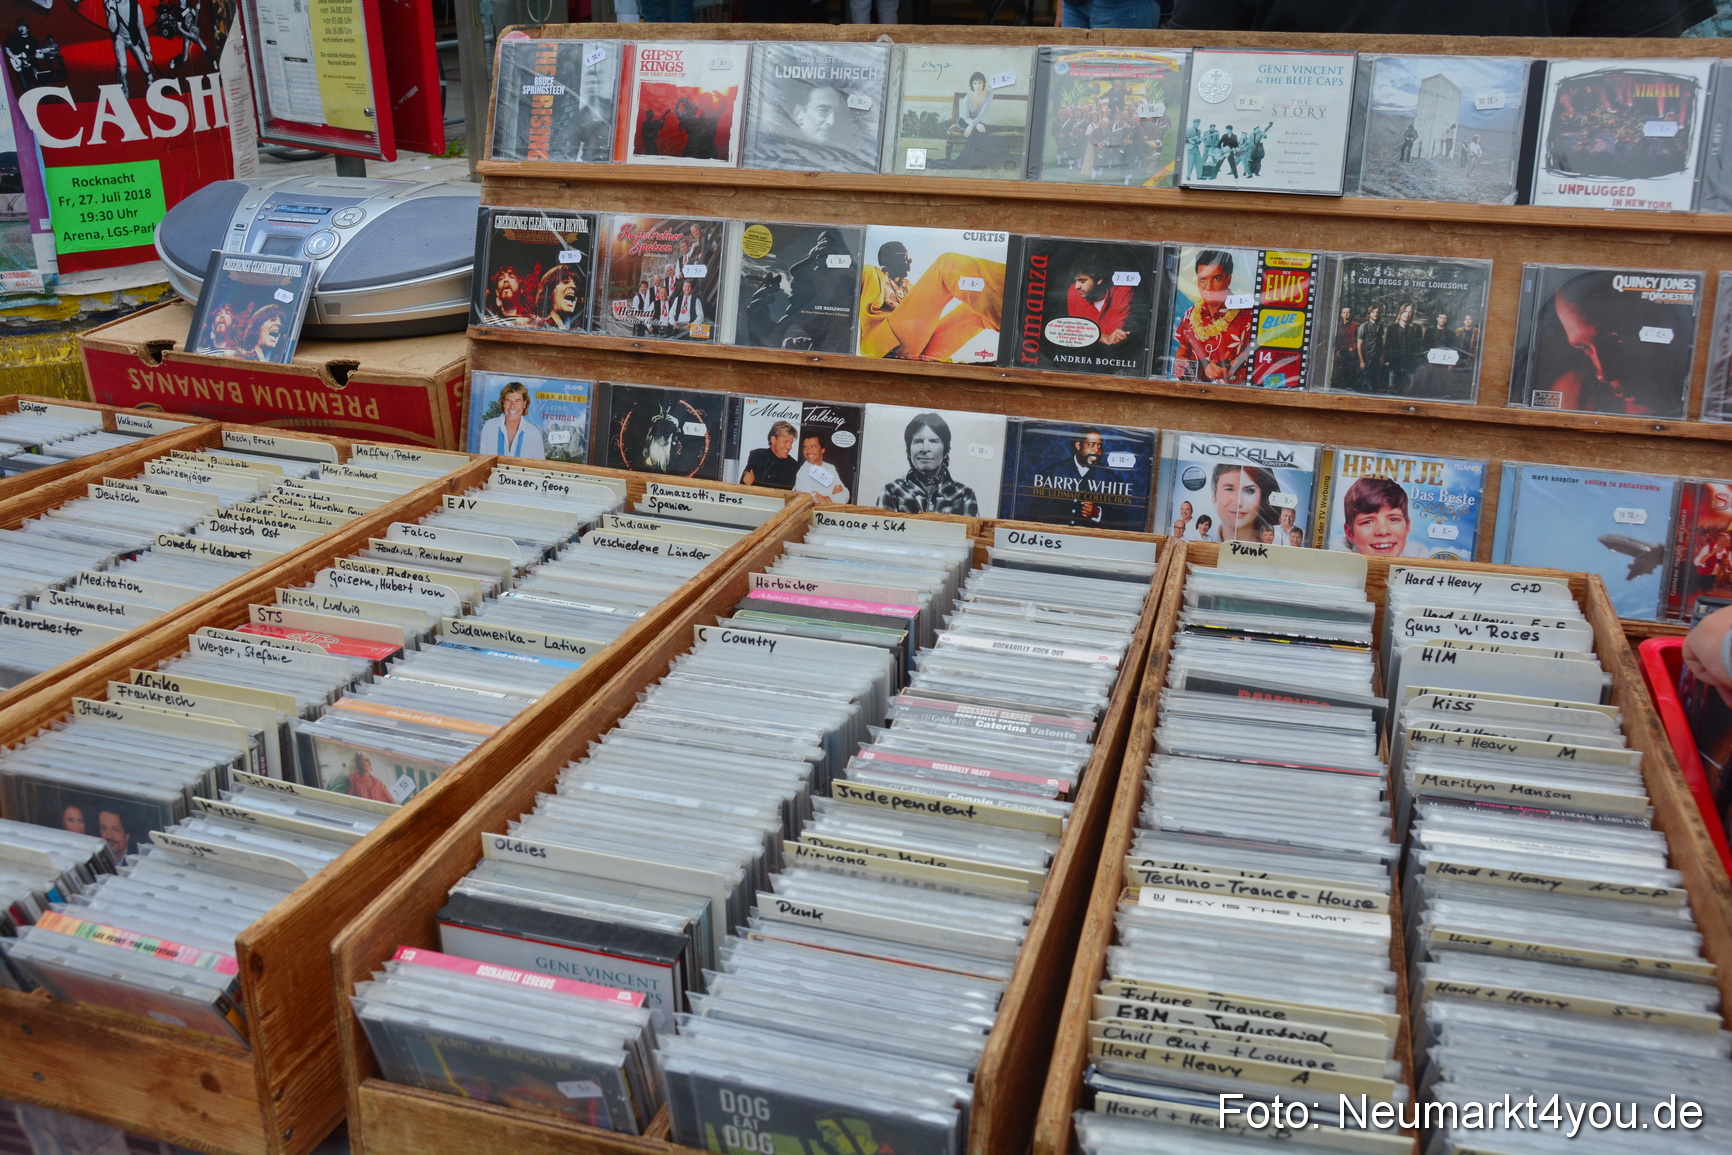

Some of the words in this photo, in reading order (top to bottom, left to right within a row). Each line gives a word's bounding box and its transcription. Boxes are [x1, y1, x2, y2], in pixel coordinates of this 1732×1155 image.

[640, 49, 683, 61] GIPSY
[817, 56, 836, 64] BESTE
[640, 61, 684, 72] KINGS
[775, 65, 826, 80] LUDWIG
[830, 66, 879, 80] HIRSCH
[1258, 64, 1289, 74] GENE
[1292, 65, 1344, 76] VINCENT
[522, 85, 564, 95] SPRINGSTEEN
[534, 76, 554, 86] BRUCE
[1256, 76, 1263, 84] &
[1286, 76, 1313, 86] BLUE
[1316, 77, 1344, 87] CAPS
[1633, 83, 1680, 98] NIRVANA
[18, 72, 229, 148] CASH
[1271, 106, 1327, 120] STORY
[527, 94, 554, 161] RISING
[72, 173, 135, 188] Rocknacht
[58, 196, 75, 207] Fr,
[78, 194, 98, 206] 27.
[101, 192, 121, 204] Juli
[124, 188, 152, 201] 2018
[1558, 184, 1635, 197] UNPLUGGED
[1625, 199, 1646, 208] NEW
[1647, 200, 1673, 209] YORK
[80, 209, 114, 223] 19:30
[117, 208, 138, 220] Uhr
[495, 215, 528, 229] CREEDENCE
[528, 217, 565, 232] CLEARWATER
[565, 218, 589, 233] REVIVAL
[63, 231, 104, 242] Arena,
[963, 232, 1006, 243] CURTIS
[629, 240, 673, 255] Spatzen
[1264, 273, 1305, 303] ELVIS
[1358, 277, 1376, 285] COLE
[1378, 278, 1402, 286] DEGGS
[1412, 280, 1426, 288] THE
[1428, 281, 1468, 290] LONESOME
[1612, 275, 1659, 292] QUINCY
[1658, 277, 1697, 292] JONES
[1649, 291, 1694, 302] ORCHESTRA
[618, 307, 655, 318] Heimat
[1020, 254, 1049, 365] romanza
[1261, 313, 1298, 330] BLUE
[1053, 354, 1093, 365] ANDREA
[1095, 357, 1137, 368] BOCELLI
[127, 367, 244, 404] BANANAS
[250, 383, 380, 421] PREMIUM
[541, 411, 576, 422] Heimat
[749, 402, 800, 420] Modern
[804, 405, 846, 431] Talking
[356, 445, 394, 460] Maffay,
[396, 449, 422, 462] Peter
[1190, 442, 1294, 463] NOCKALM
[150, 464, 212, 484] Schürzenjäger
[1340, 453, 1445, 486] HEINTJE
[498, 473, 538, 490] Danzer,
[541, 479, 570, 495] Georg
[1033, 474, 1083, 491] BARRY
[1087, 479, 1134, 496] WHITE
[95, 487, 140, 503] Deutsch
[650, 483, 715, 502] Ramazzotti,
[719, 493, 743, 505] Eros
[1033, 488, 1046, 496] THE
[1048, 490, 1081, 500] ULTIMATE
[1084, 492, 1132, 504] COLLECTION
[1410, 486, 1435, 501] Das
[1438, 492, 1475, 506] Beste
[648, 496, 693, 513] Spanien
[210, 520, 255, 536] Deutsch
[262, 522, 281, 538] Ost
[401, 525, 437, 540] Falco
[592, 536, 660, 555] Veschiedene
[667, 543, 711, 560] Länder
[1008, 531, 1063, 550] Oldies
[375, 542, 417, 558] Fendrich,
[419, 549, 463, 564] Reinhard
[1230, 543, 1268, 558] Punk
[79, 572, 143, 593] Meditation
[329, 571, 378, 591] Goisern,
[380, 577, 413, 593] Hubert
[421, 587, 445, 598] von
[756, 576, 819, 592] Hörbücher
[282, 591, 319, 611] Hirsch,
[322, 596, 360, 616] Ludwig
[257, 607, 283, 623] STS
[721, 631, 777, 653] Country
[198, 641, 240, 658] Werger,
[245, 646, 292, 664] Stefanie
[1421, 648, 1457, 664] HIM
[117, 685, 195, 708] Frankreich
[931, 714, 957, 725] Golden
[975, 720, 1027, 734] Caterina
[1030, 727, 1077, 740] Valente
[1410, 730, 1446, 745] Hard
[1454, 736, 1465, 746] +
[1471, 736, 1518, 753] Heavy
[1557, 747, 1576, 760] M
[931, 762, 970, 776] ROCKABILLY
[970, 768, 991, 777] PARTY
[1421, 773, 1495, 793] Marilyn
[1509, 783, 1573, 801] Manson
[837, 784, 977, 818] Independent
[495, 838, 547, 858] Oldies
[796, 846, 867, 866] Nirvana
[776, 900, 824, 920] Punk
[1175, 897, 1215, 907] SKY
[1246, 906, 1291, 916] THE
[1297, 912, 1353, 923] LIMIT
[400, 949, 416, 962] 2CD
[476, 964, 522, 986] ROCKABILLY
[522, 973, 556, 990] LEGENDS
[535, 956, 580, 975] GENE
[584, 965, 660, 991] VINCENT
[1120, 987, 1193, 1008] Future
[1207, 998, 1287, 1020] Trance
[1100, 1043, 1147, 1060] Hard
[1162, 1053, 1174, 1064] +
[1182, 1056, 1244, 1077] Heavy
[1290, 1071, 1311, 1084] A
[719, 1088, 771, 1121] DOG
[733, 1115, 759, 1131] EAT
[724, 1124, 775, 1155] DOG
